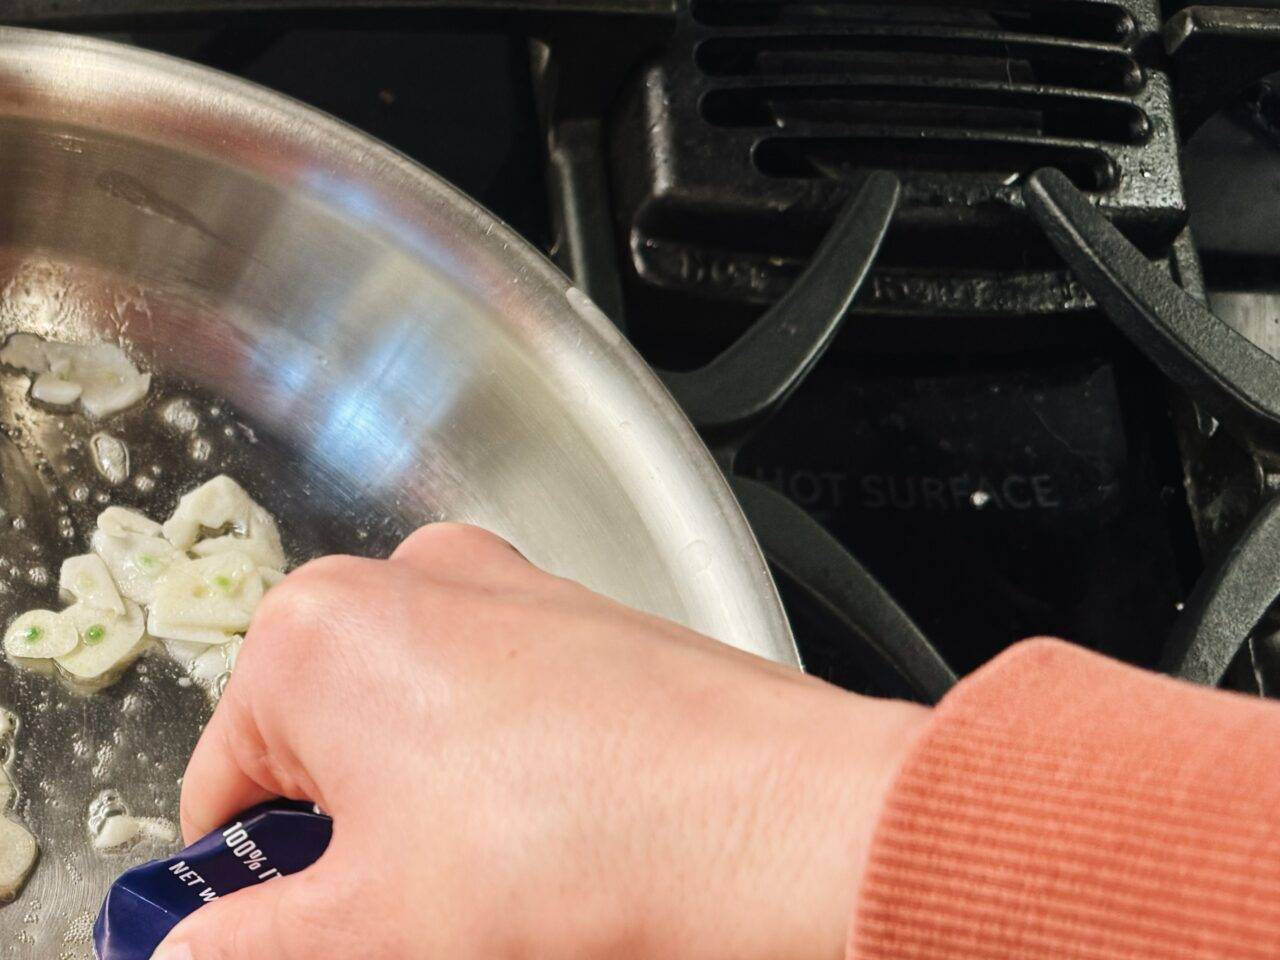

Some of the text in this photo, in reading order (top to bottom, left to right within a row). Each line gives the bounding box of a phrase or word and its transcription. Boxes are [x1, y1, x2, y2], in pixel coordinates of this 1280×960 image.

[860, 473, 1060, 510] SURFACE
[222, 821, 267, 871] 100%
[168, 860, 206, 887] NET
